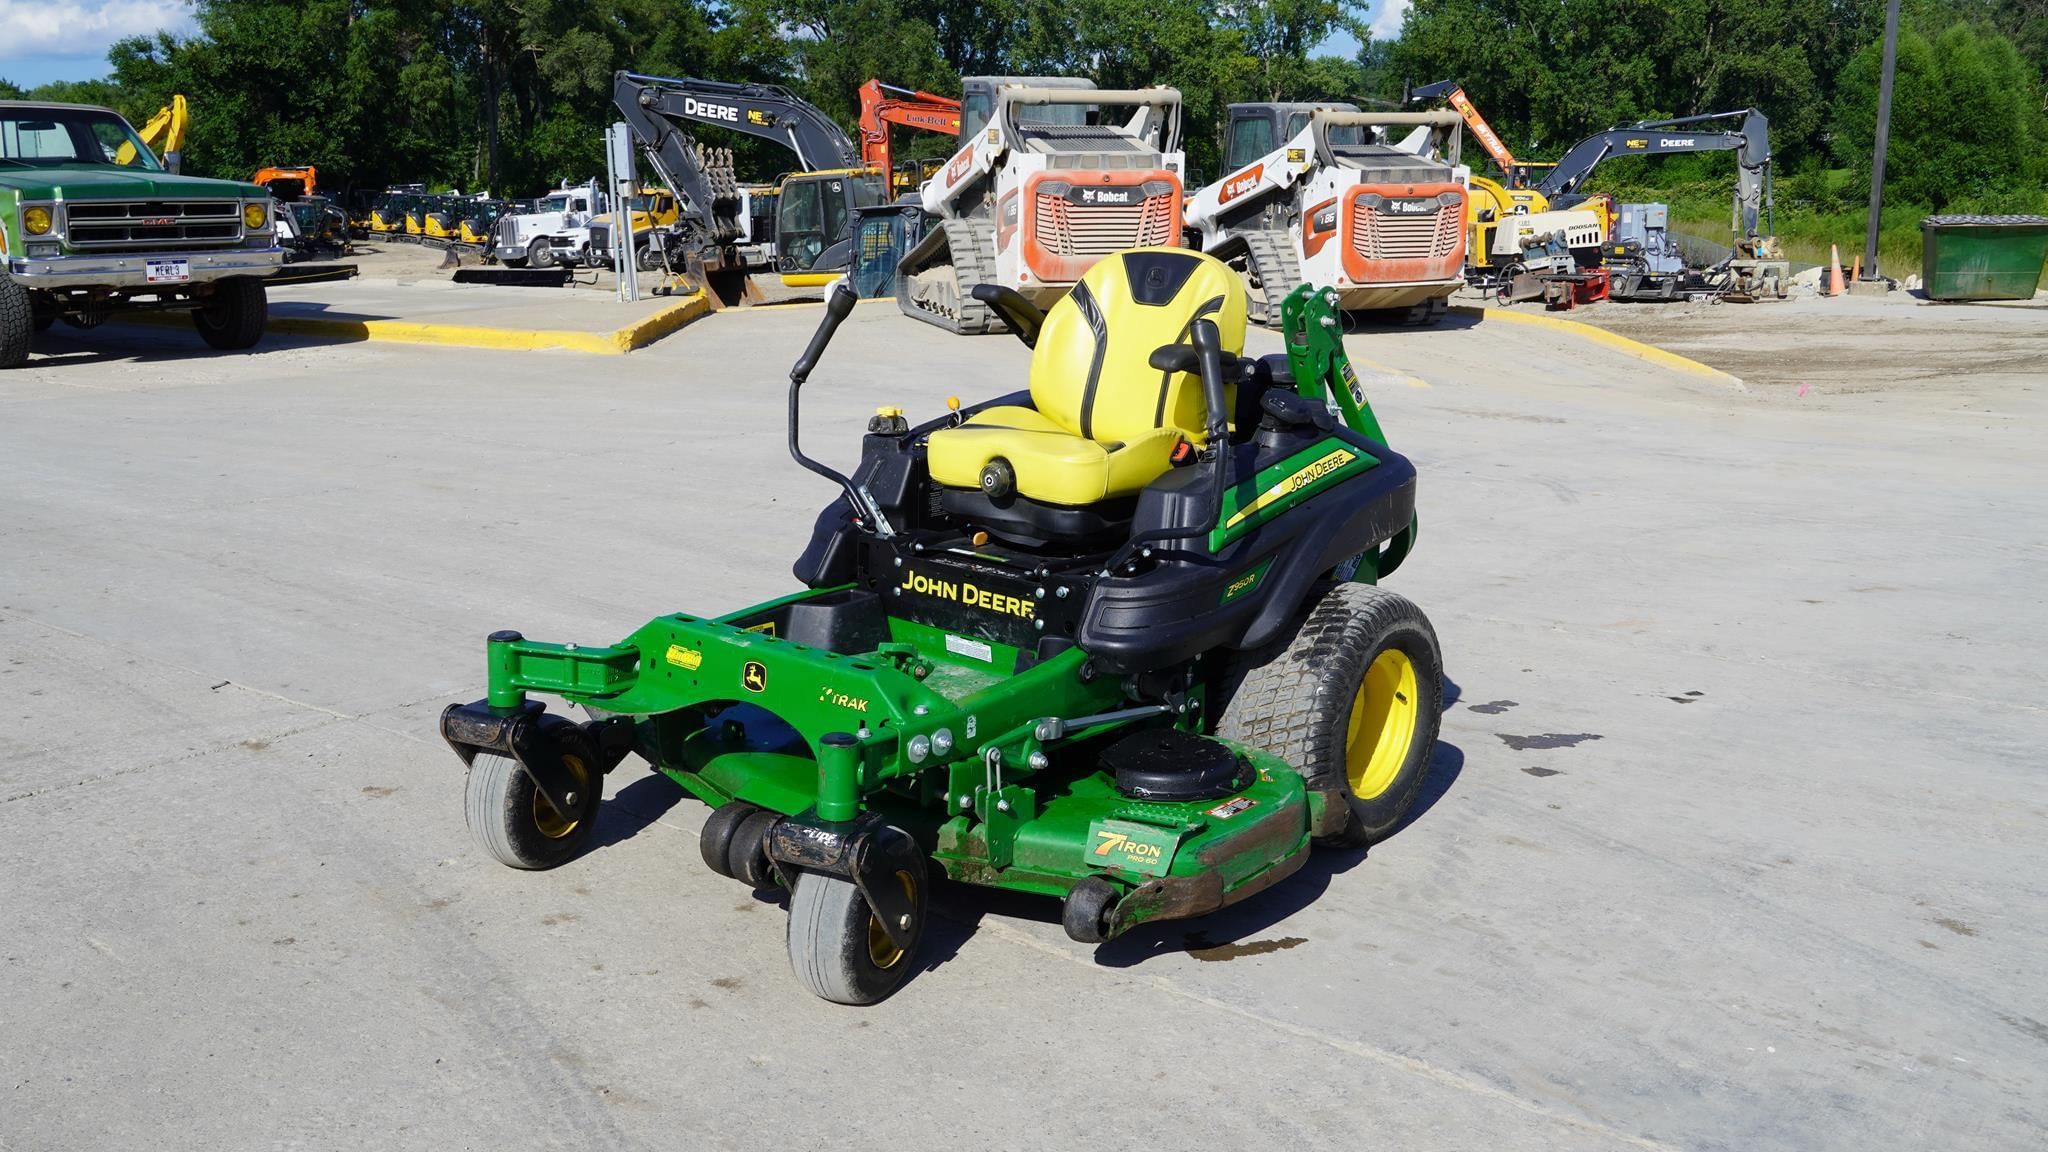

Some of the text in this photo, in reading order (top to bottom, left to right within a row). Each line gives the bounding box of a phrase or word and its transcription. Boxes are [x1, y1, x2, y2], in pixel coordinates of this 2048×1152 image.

[685, 98, 738, 122] DEERE
[748, 110, 762, 121] NE
[1660, 138, 1695, 147] DEERE
[1287, 149, 1298, 159] NE
[1236, 174, 1257, 194] Bobcat
[1097, 191, 1128, 203] Bobcat
[156, 266, 180, 276] MERL3
[1290, 453, 1345, 491] JOHN DEERE
[1226, 574, 1256, 598] Z950R
[902, 570, 1035, 619] JOHN DEERE
[1127, 855, 1144, 864] PRO
